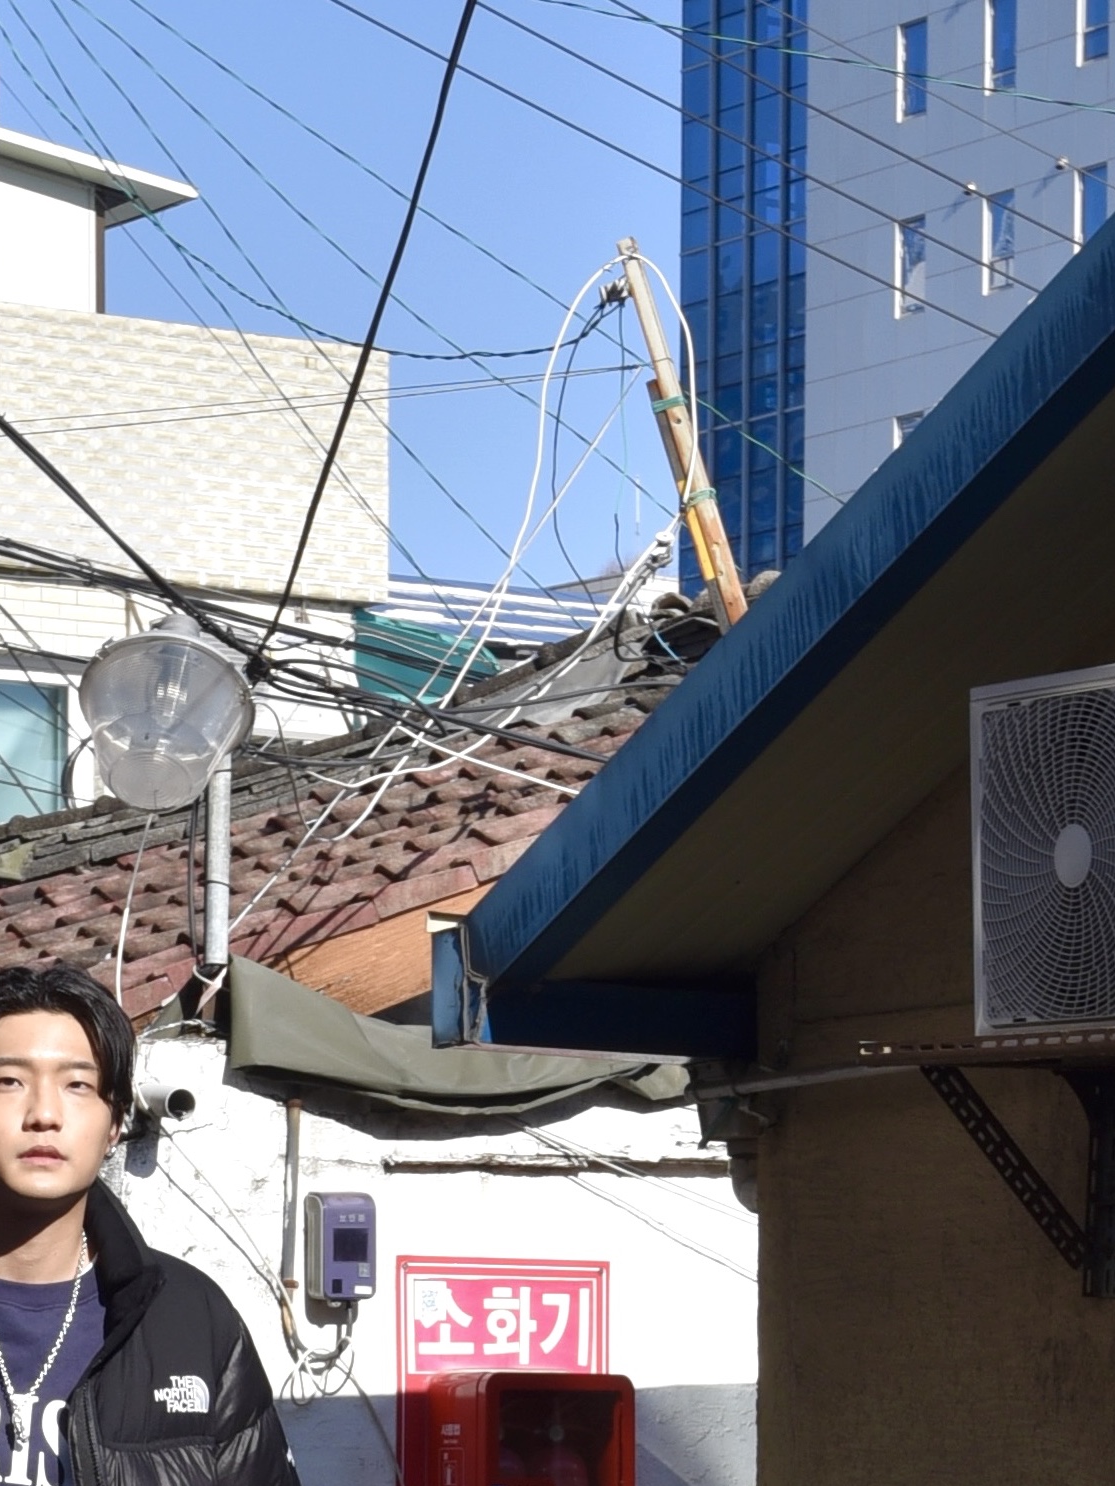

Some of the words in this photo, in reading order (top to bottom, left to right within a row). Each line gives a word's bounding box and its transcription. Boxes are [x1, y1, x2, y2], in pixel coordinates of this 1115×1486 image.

[418, 1286, 590, 1366] 소화기
[169, 1375, 194, 1388] THE
[153, 1387, 195, 1403] NORTH
[166, 1400, 196, 1414] FACE
